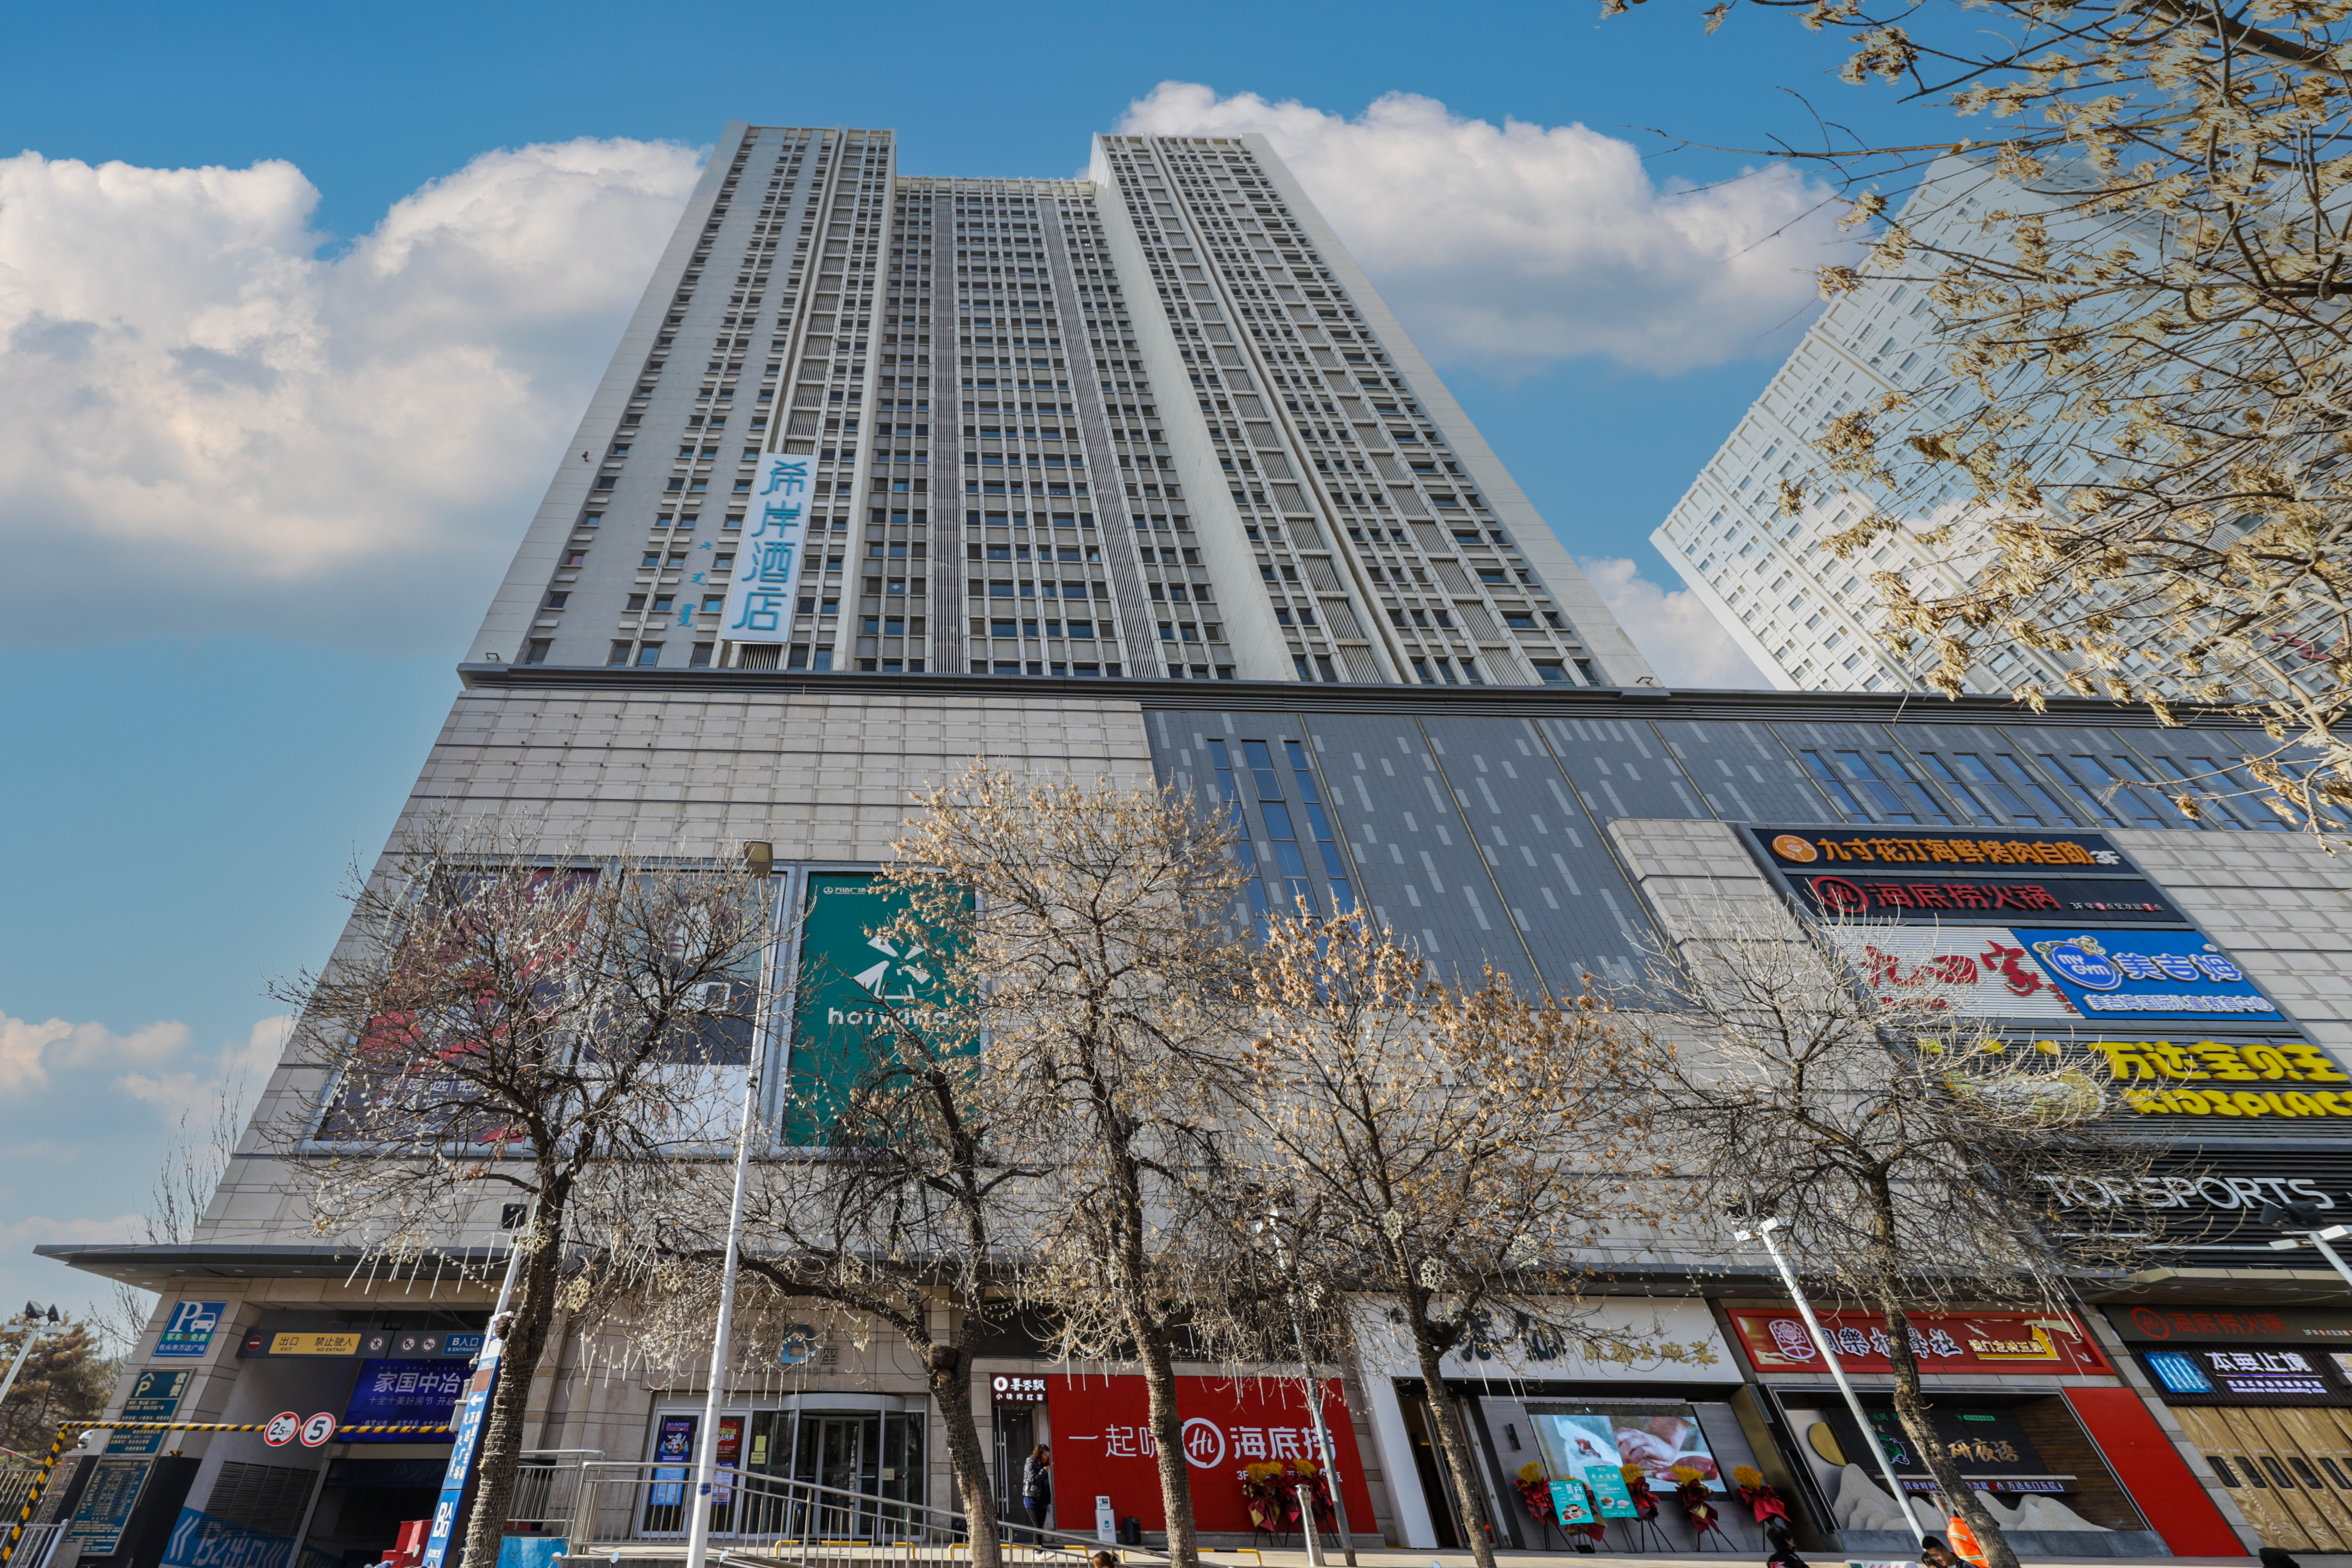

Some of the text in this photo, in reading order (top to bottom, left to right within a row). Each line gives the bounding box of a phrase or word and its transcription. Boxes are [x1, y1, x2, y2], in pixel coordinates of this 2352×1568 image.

[731, 460, 808, 630] 希岸酒店
[1817, 837, 2119, 865] 九寸花汀海鲜烤肉自助 3F
[1864, 883, 2062, 909] 海底捞火锅
[2060, 954, 2084, 965] MY
[2072, 963, 2112, 976] GYM
[2112, 952, 2243, 983] 美吉姆
[2084, 994, 2276, 1013] 美吉姆国际儿童教育中心
[2087, 1040, 2351, 1083] 万达宝贝王
[168, 1302, 203, 1332] P
[2165, 1313, 2292, 1334] 海底捞火锅
[166, 1333, 208, 1341] 军车 免费
[279, 1337, 352, 1347] 出口 禁止驶入
[452, 1338, 479, 1347] B入口
[781, 1324, 815, 1364] B
[820, 1346, 838, 1364] 座
[2204, 1352, 2313, 1372] 本無止境
[135, 1381, 151, 1397] P
[373, 1372, 461, 1393] 家国中冶
[1010, 1377, 1046, 1391] 薯香飘
[368, 1396, 434, 1406] 十全十美好房节
[270, 1422, 291, 1436] 2.5m
[308, 1420, 327, 1440] 5
